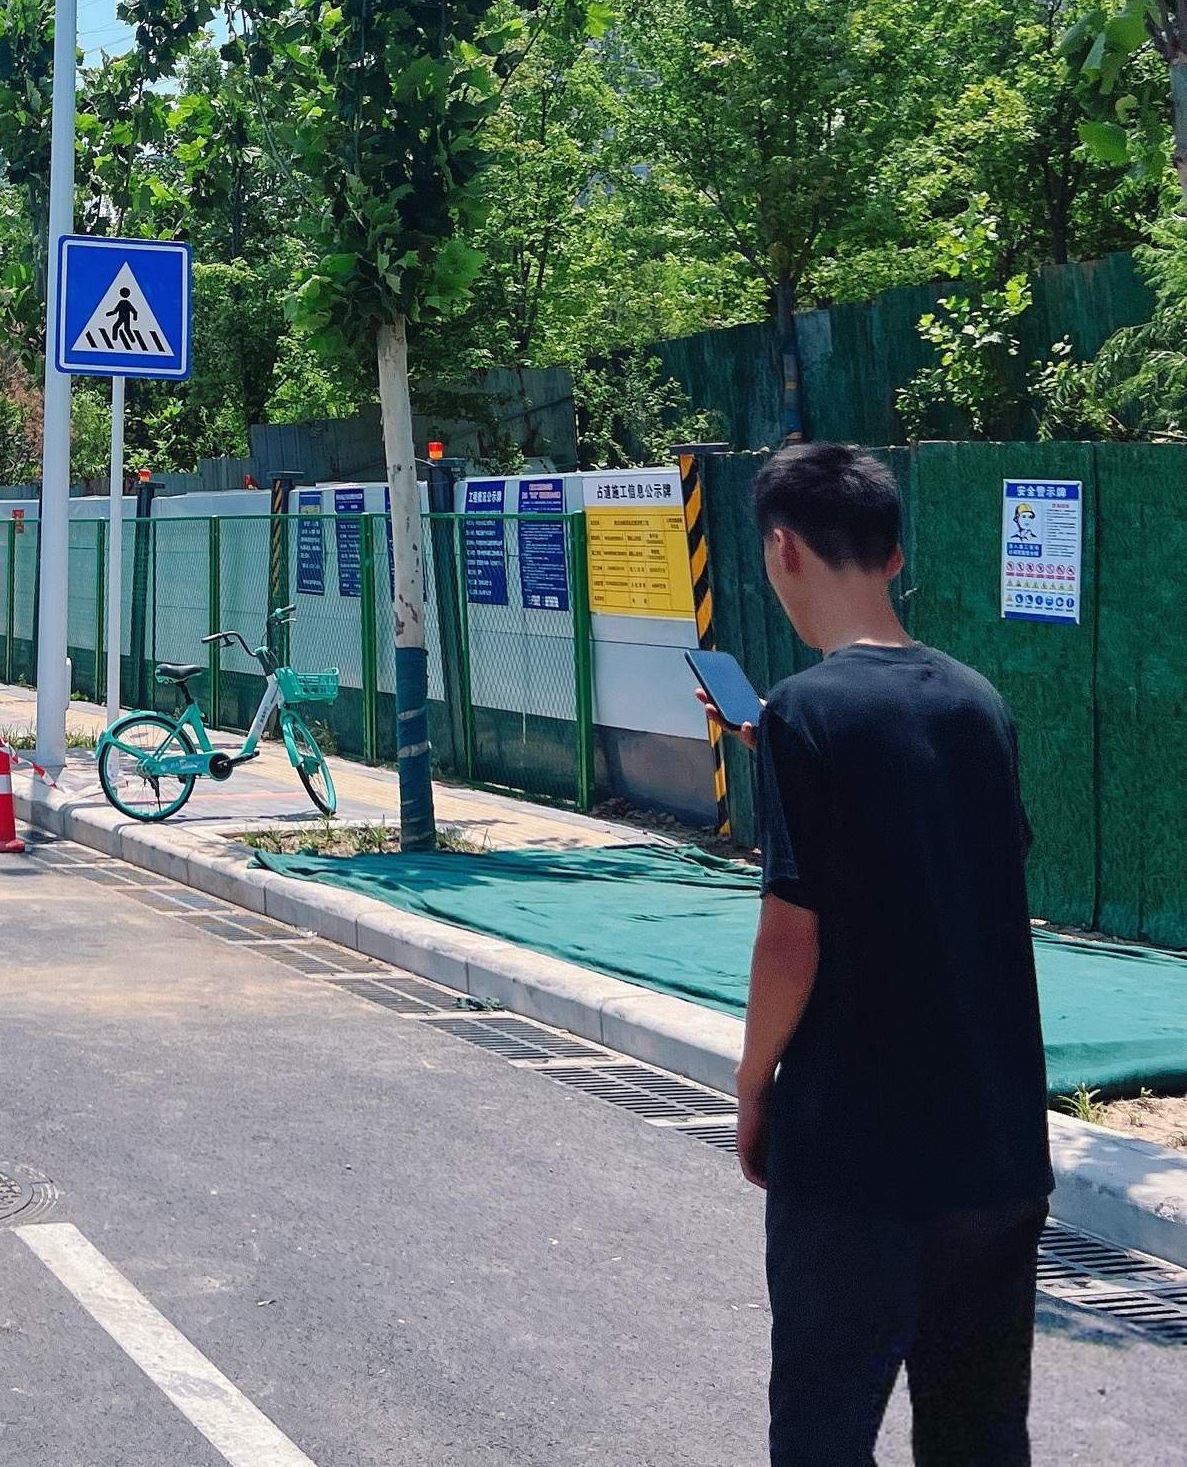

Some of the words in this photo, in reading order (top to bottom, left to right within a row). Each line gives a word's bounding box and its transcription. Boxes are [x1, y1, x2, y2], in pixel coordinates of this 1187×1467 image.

[596, 483, 672, 500] 占道施工信息公示牌
[1016, 485, 1067, 498] 安全警示牌
